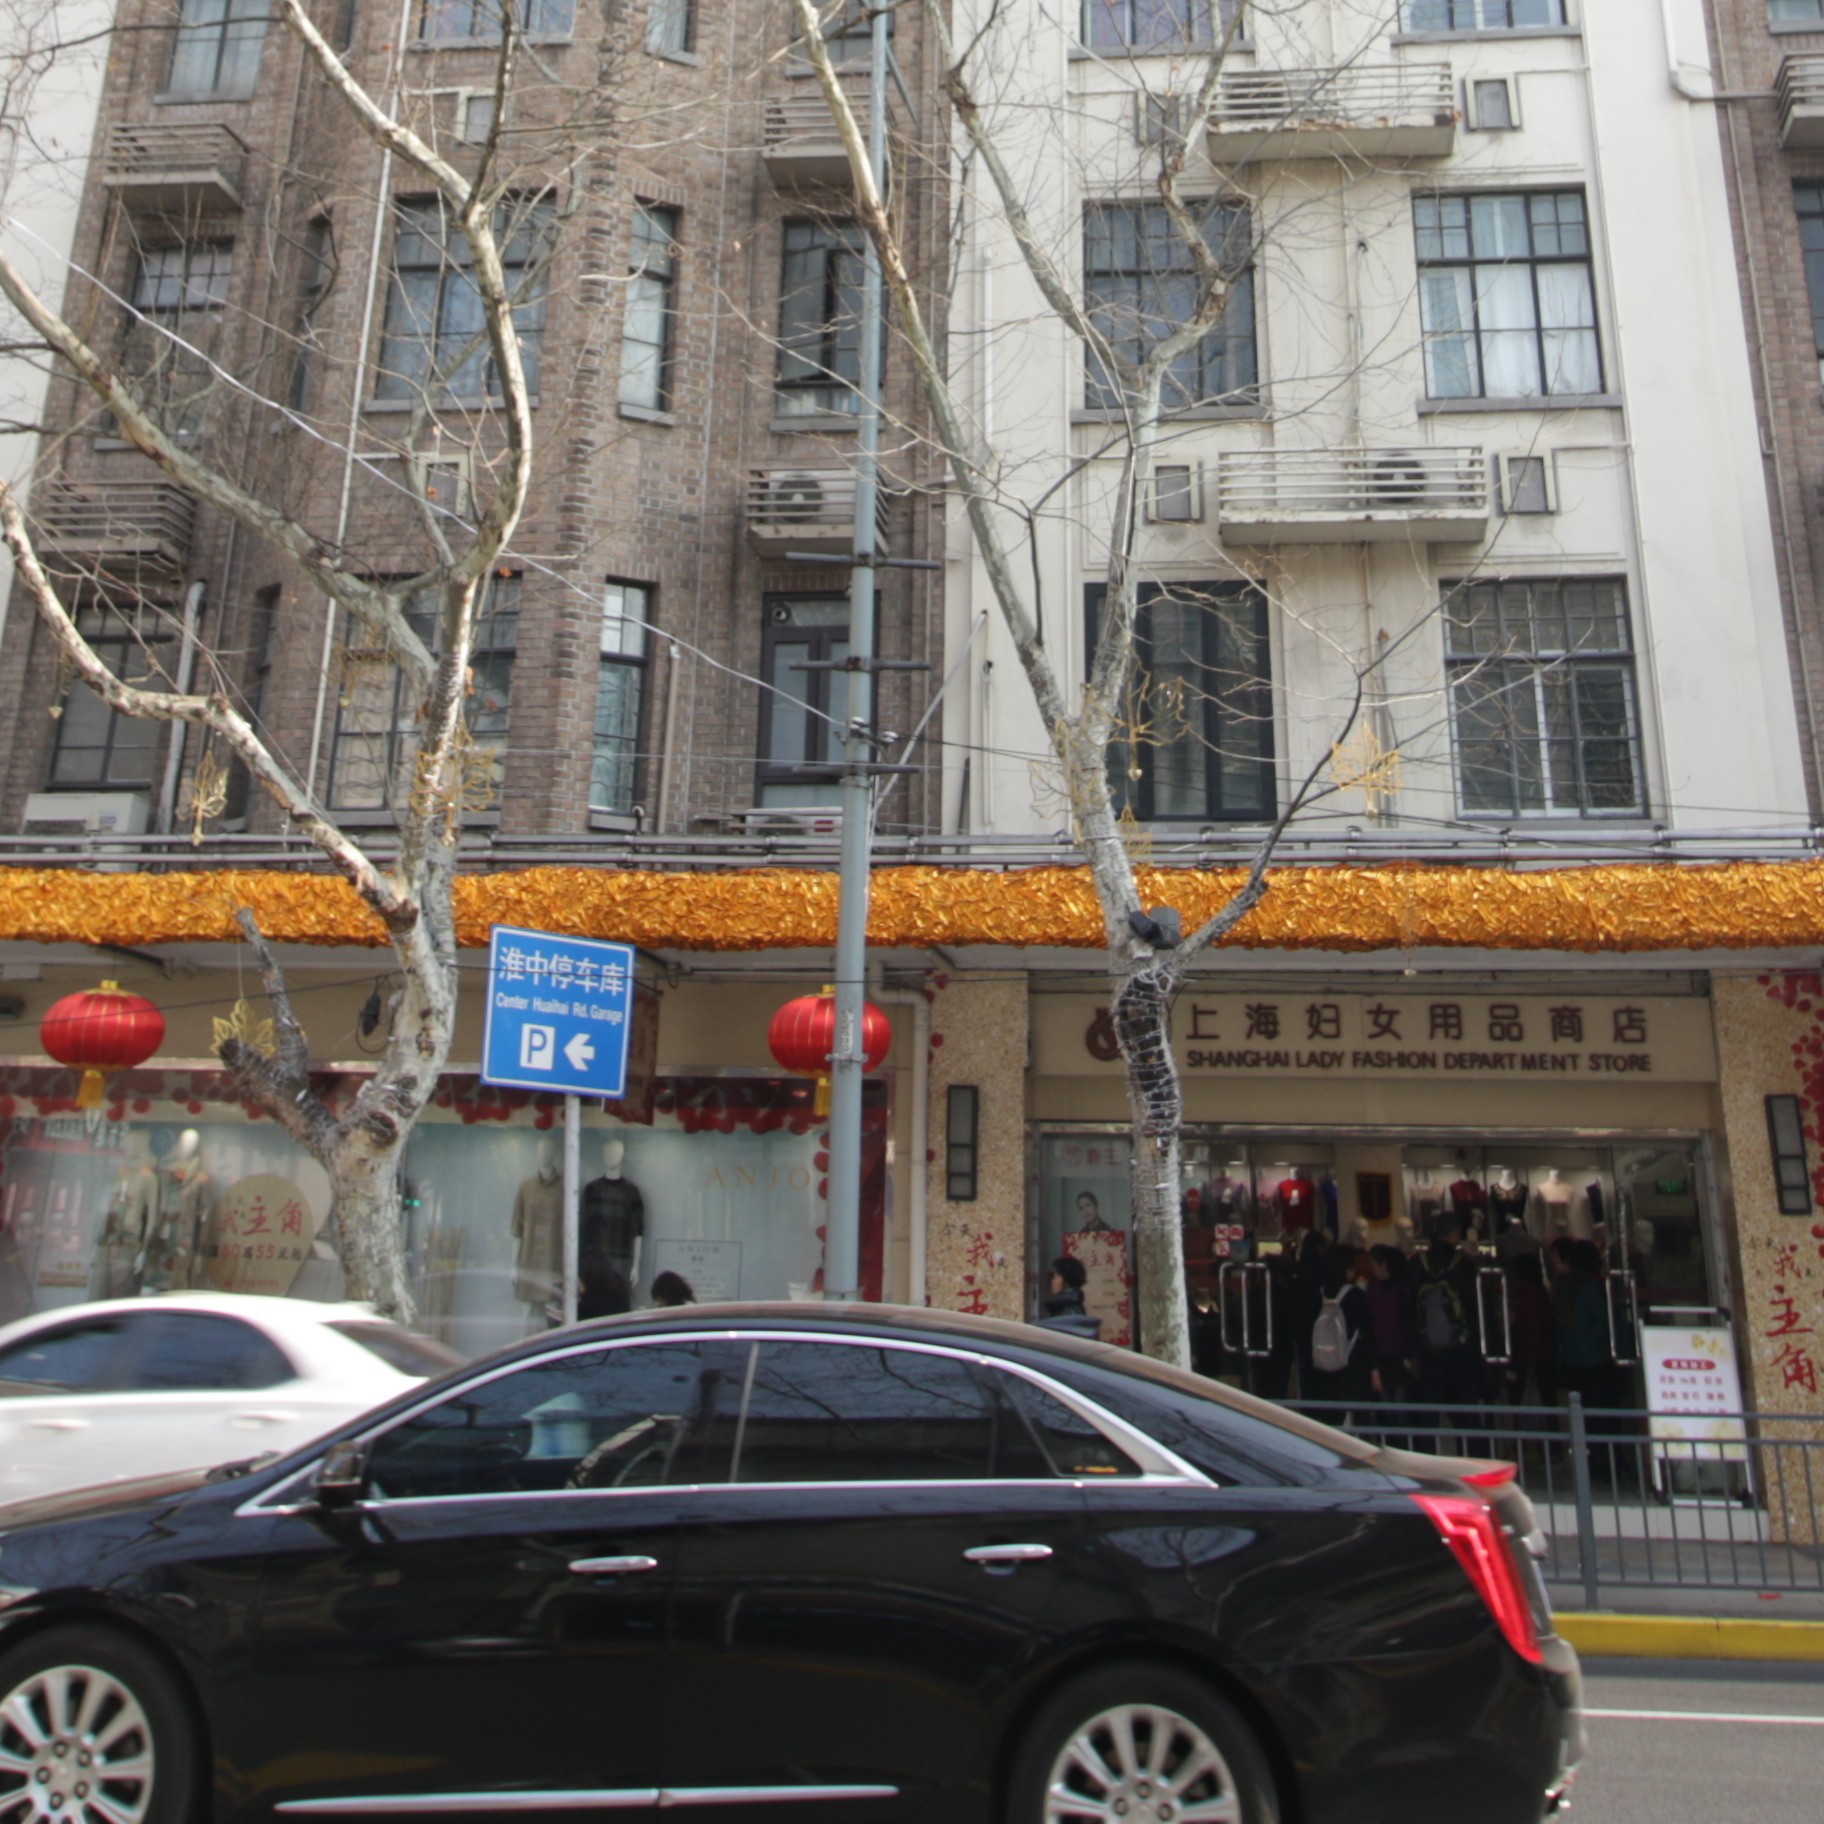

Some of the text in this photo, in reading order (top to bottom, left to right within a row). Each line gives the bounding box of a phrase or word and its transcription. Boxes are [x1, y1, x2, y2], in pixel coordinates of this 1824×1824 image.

[498, 945, 625, 996] 淮中停车库
[495, 991, 529, 1010] Center
[532, 997, 569, 1015] Huaihai
[1185, 1002, 1648, 1044] 上海妇女用品商店
[1186, 1049, 1289, 1068] SHANGHAI
[1296, 1050, 1345, 1068] LADY
[1352, 1051, 1436, 1069] FASHION
[1588, 1053, 1652, 1072] STORE
